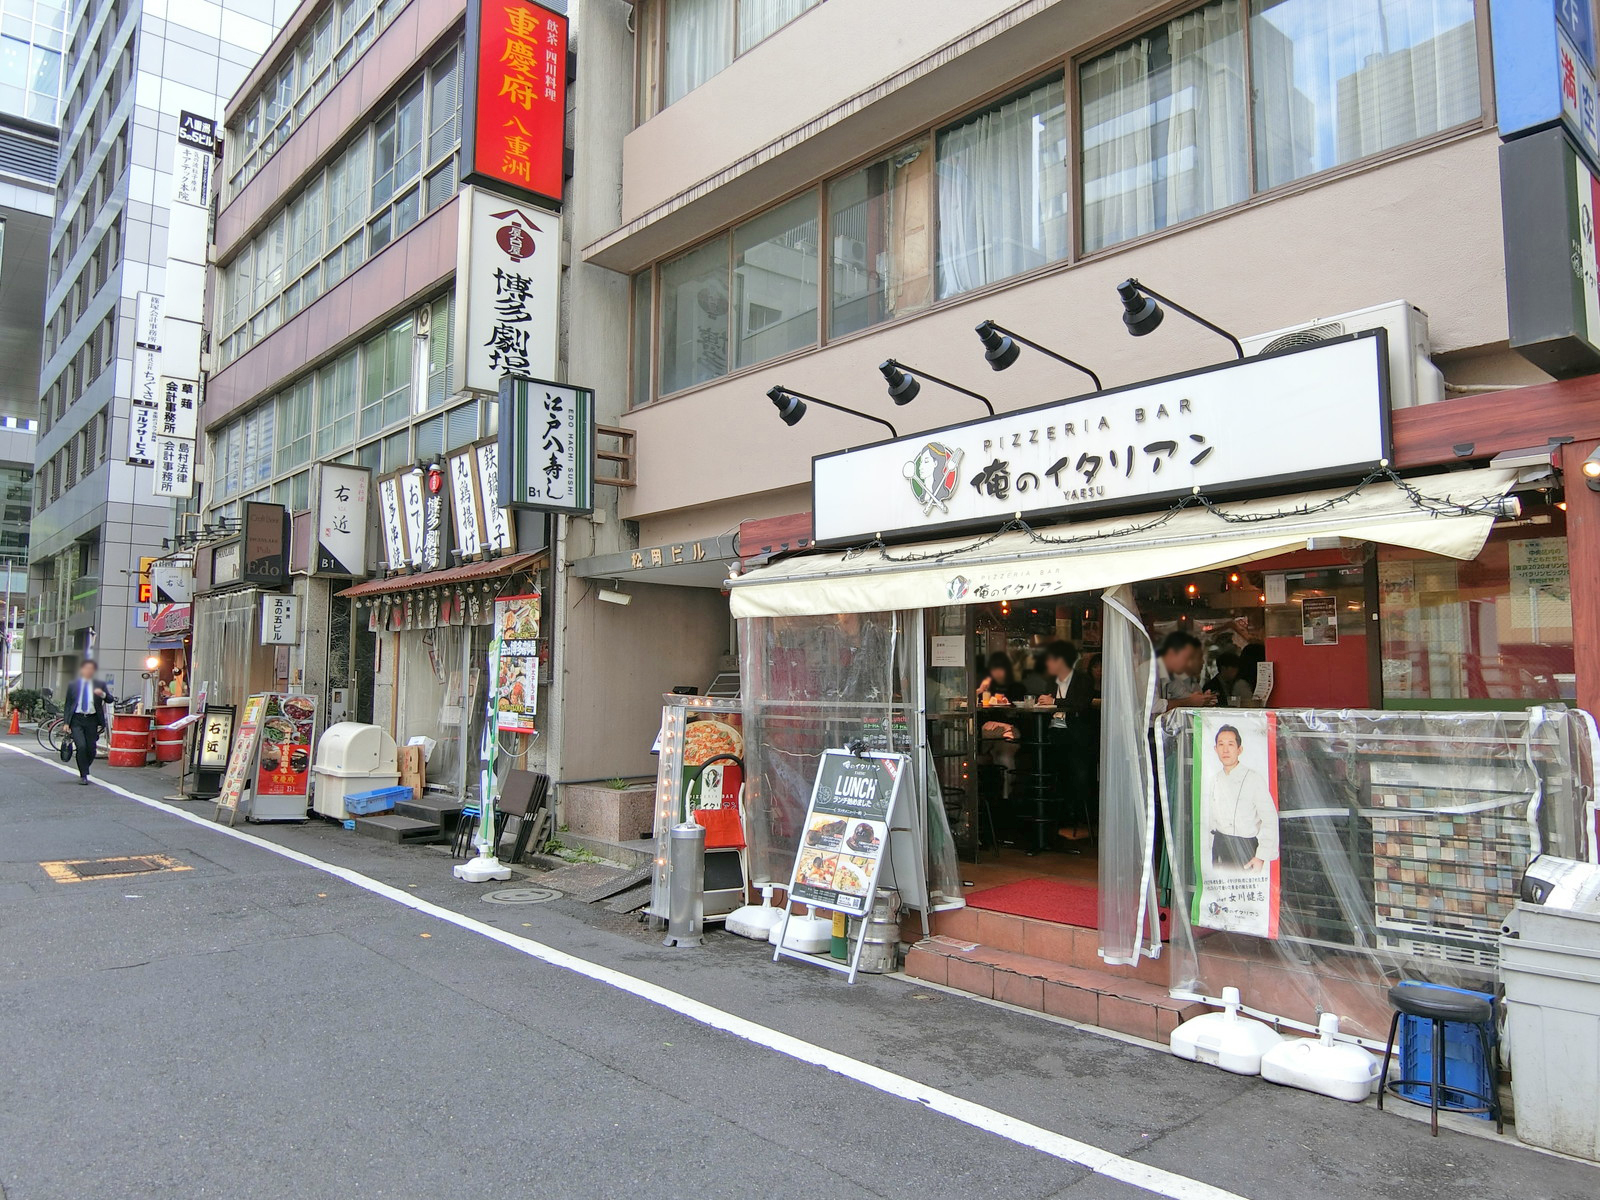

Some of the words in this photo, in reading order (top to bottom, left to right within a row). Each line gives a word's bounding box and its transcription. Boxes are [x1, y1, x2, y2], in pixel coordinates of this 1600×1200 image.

[498, 6, 539, 111] 重慶府
[1561, 46, 1577, 109] 満
[184, 117, 211, 134] 八重洲
[1581, 83, 1596, 140] 空
[179, 126, 213, 147] 5の5ビル
[502, 115, 532, 182] 八重洲
[484, 267, 534, 377] 博多劇場
[163, 381, 178, 434] 会計事務所
[181, 383, 193, 410] 草薙
[135, 409, 149, 456] ゴルフサービス
[542, 392, 565, 499] 江戸八寿し
[982, 416, 1110, 452] PIZZERIA
[1134, 398, 1194, 423] BAR
[160, 440, 175, 492] 会計事務所
[177, 442, 190, 483] 島村法律
[969, 434, 1216, 502] 俺のイタリアン
[333, 485, 351, 534] 右近
[528, 487, 541, 498] B1
[1062, 485, 1106, 501] YAESU
[423, 495, 443, 571] 博多劇場
[248, 561, 280, 576] Edo
[322, 558, 335, 569] B1
[980, 570, 1032, 581] PIZZERIA
[1039, 567, 1062, 577] BAR
[973, 580, 1064, 600] 俺のイタリアン
[273, 598, 283, 641] 五の五ビル
[207, 722, 222, 753] 右近
[832, 796, 873, 808] ランチ始めました
[834, 775, 878, 800] LUNCH
